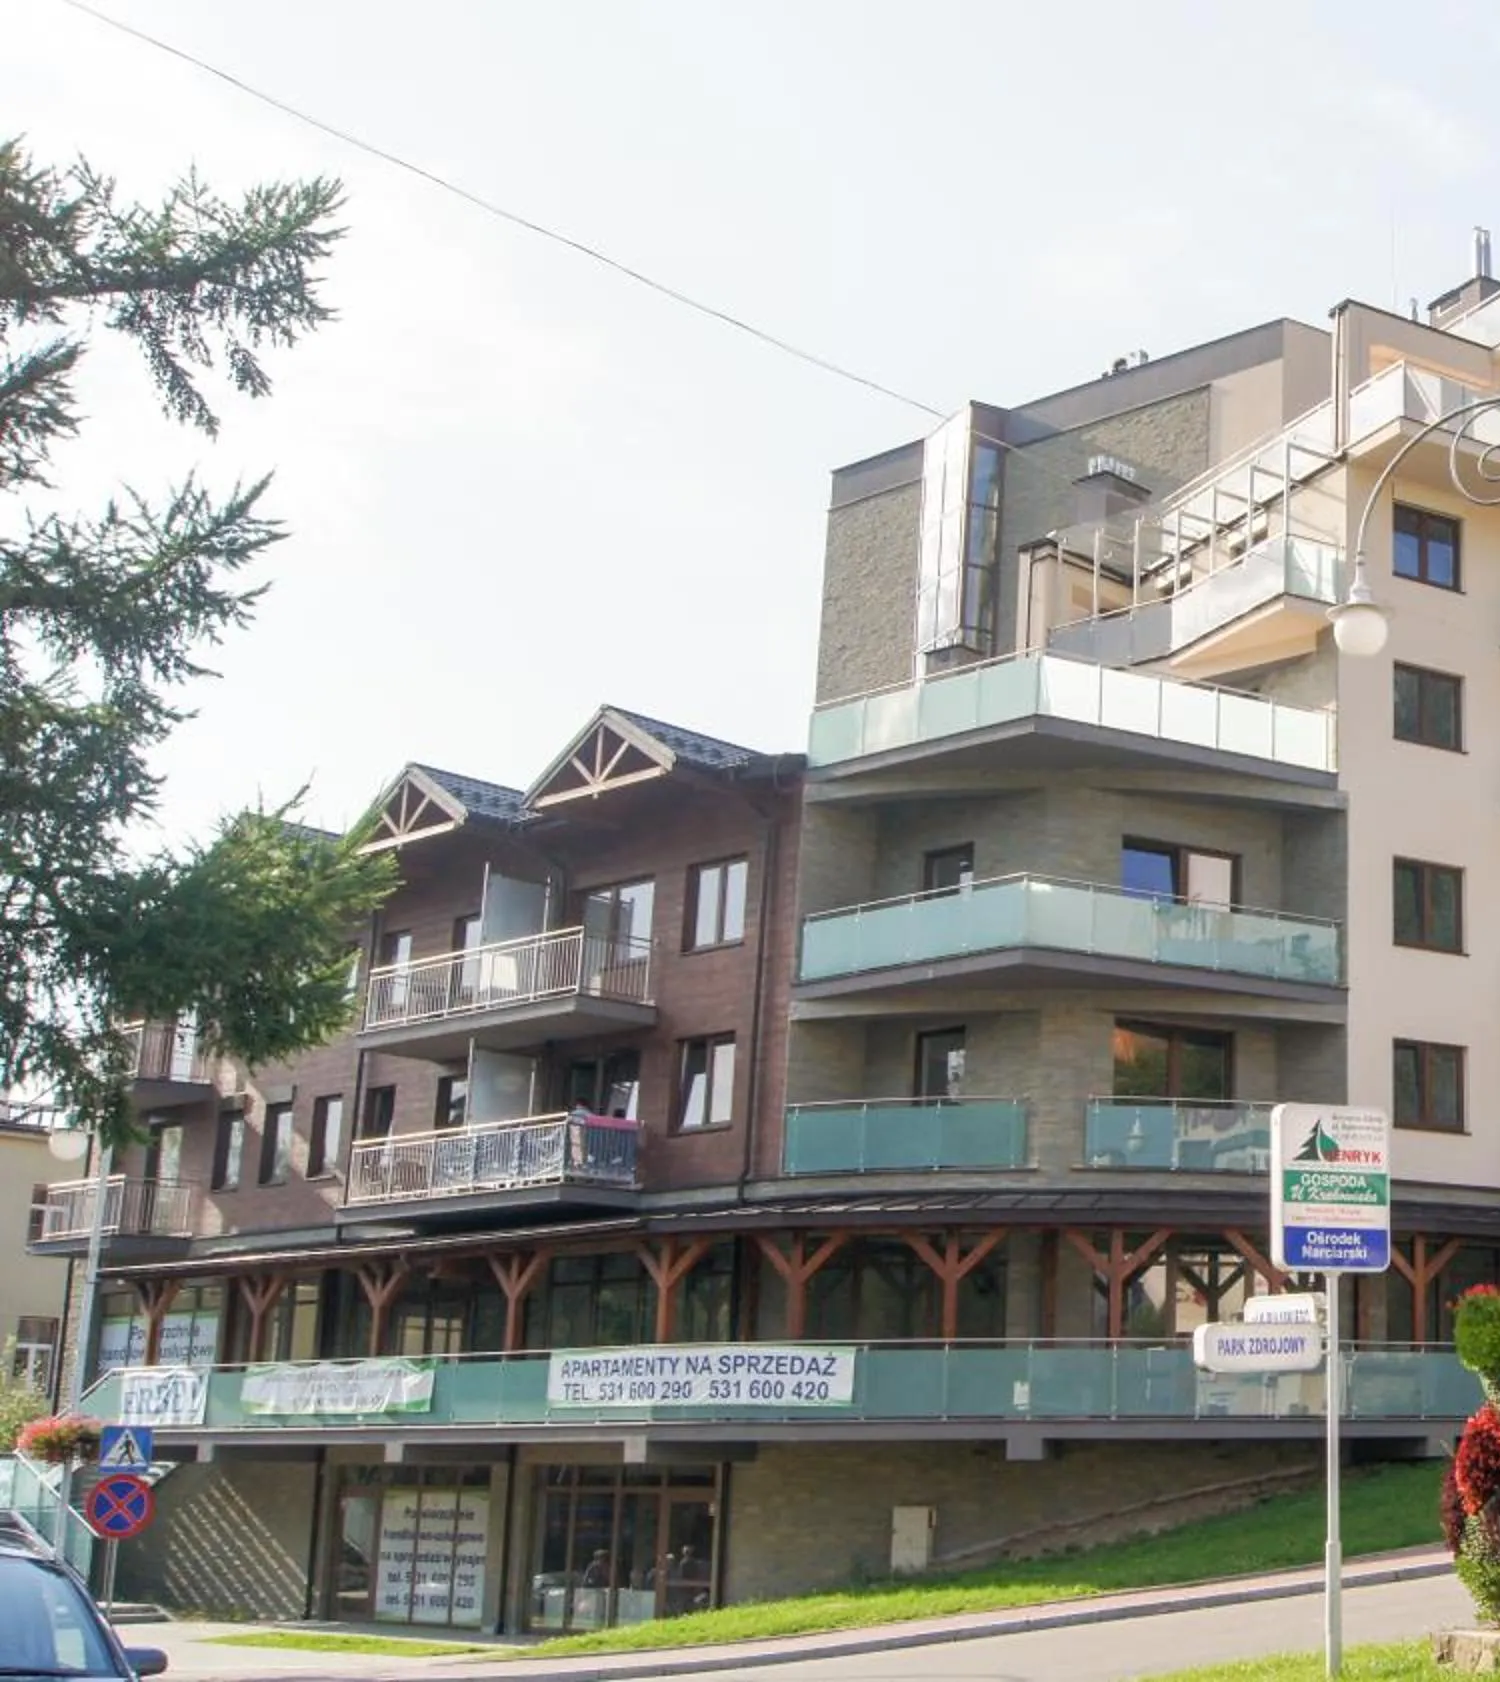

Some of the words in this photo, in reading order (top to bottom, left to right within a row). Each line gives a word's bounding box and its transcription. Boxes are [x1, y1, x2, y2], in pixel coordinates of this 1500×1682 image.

[1301, 1173, 1368, 1189] GOSPODA
[1307, 1231, 1362, 1245] Ośrodek
[1301, 1245, 1368, 1260] Narciarski
[1217, 1338, 1246, 1356] PARK
[1248, 1336, 1306, 1355] ZDROJOWY
[561, 1357, 680, 1379] APARTAMENTY
[685, 1355, 713, 1376] NA
[718, 1351, 838, 1376] SPRZEDAŻ
[599, 1382, 624, 1401] 531
[628, 1381, 656, 1400] 600
[660, 1380, 693, 1399] 290
[708, 1379, 743, 1399] 531
[749, 1379, 785, 1399] 600
[791, 1380, 830, 1400] 420
